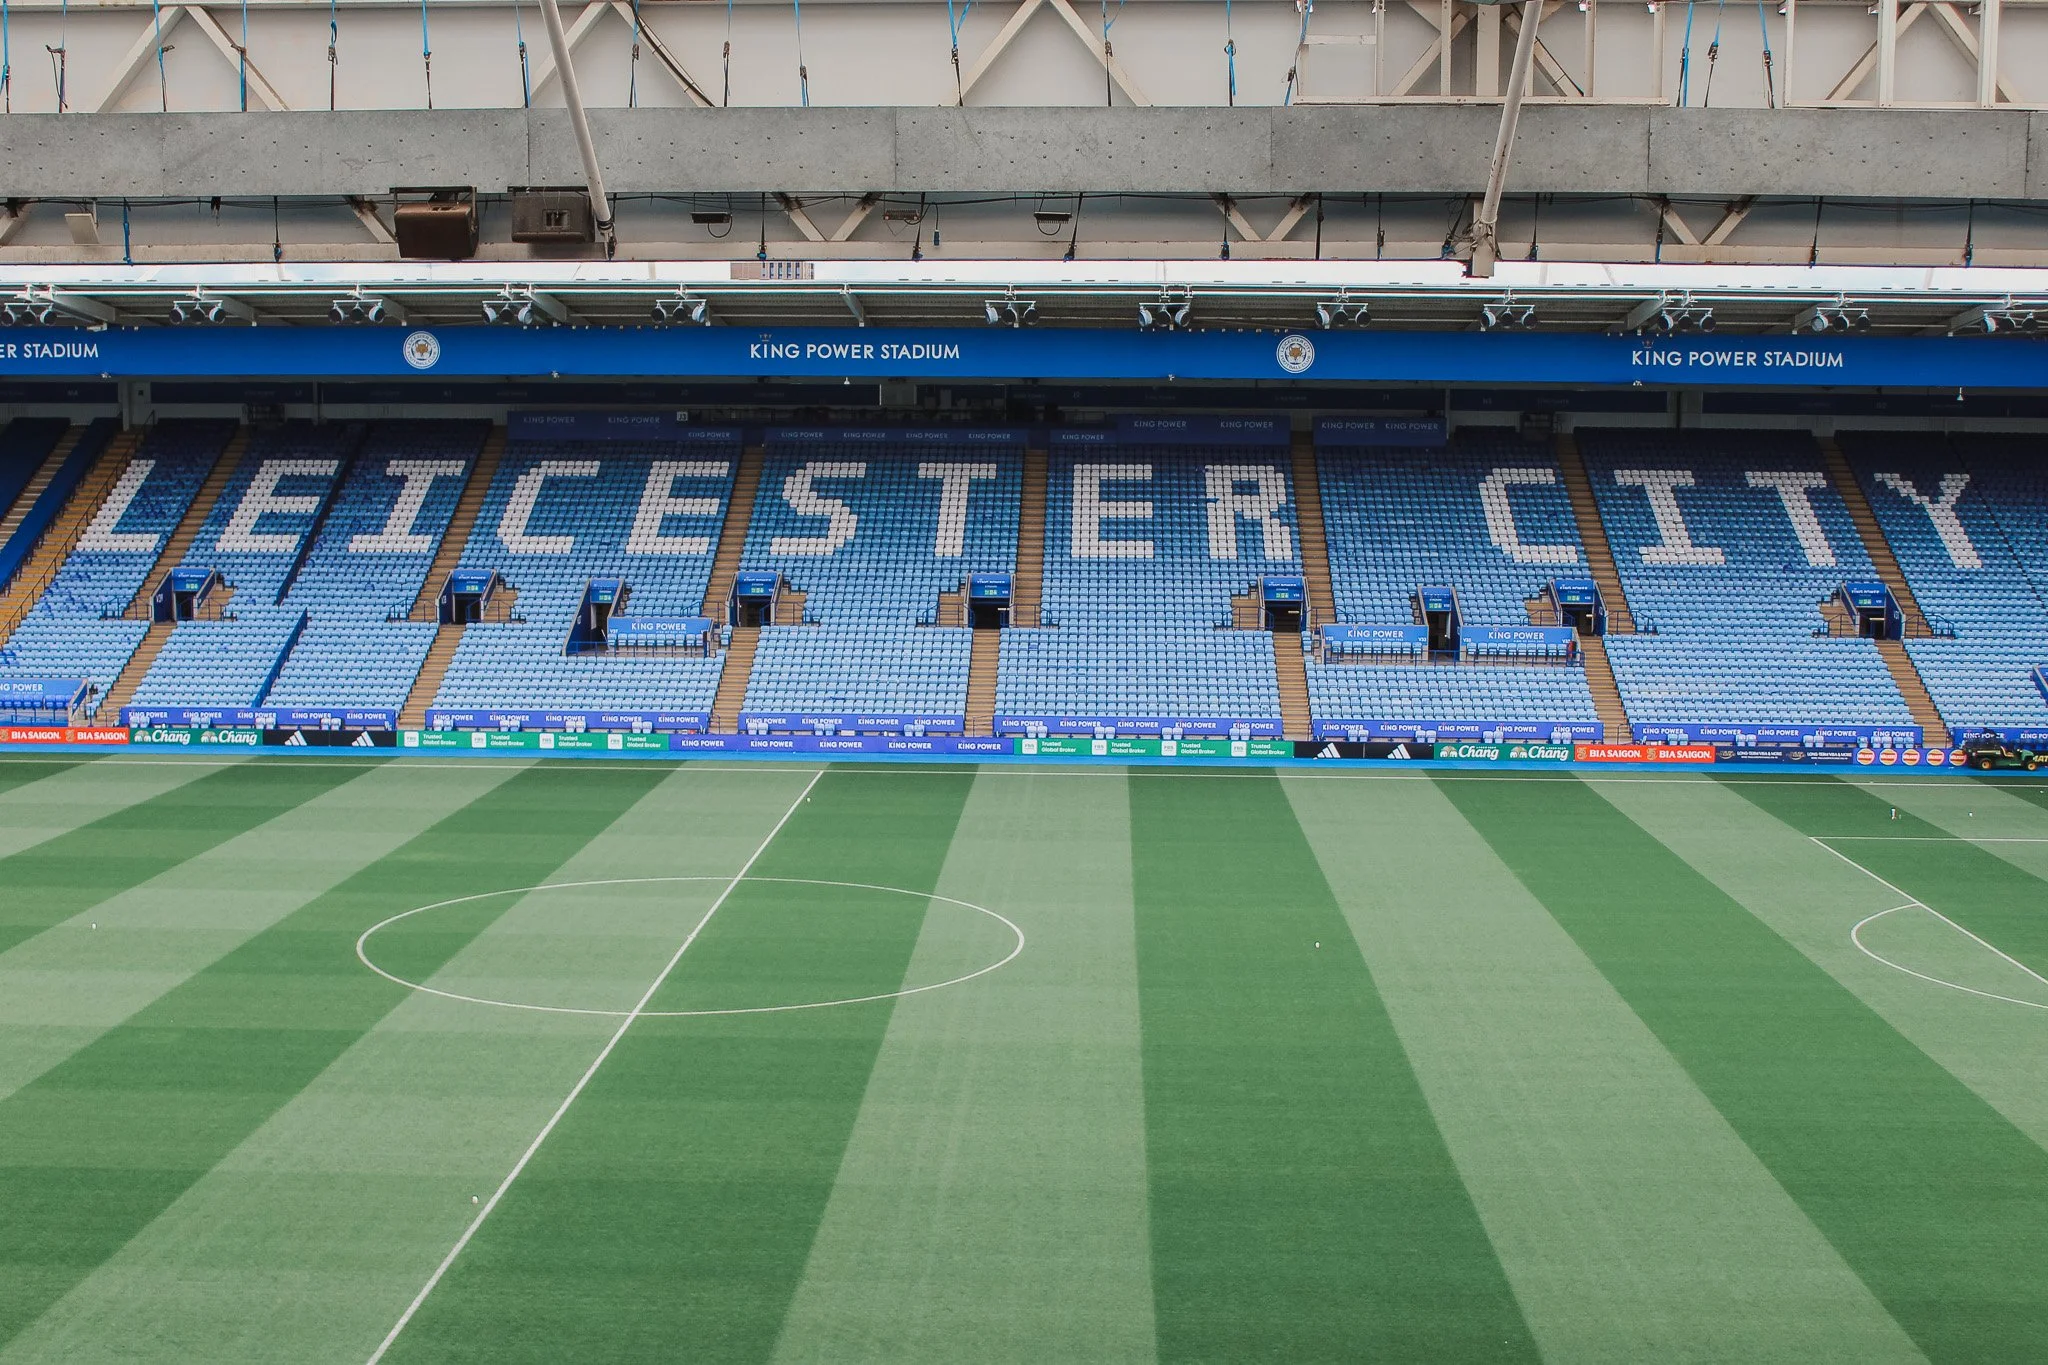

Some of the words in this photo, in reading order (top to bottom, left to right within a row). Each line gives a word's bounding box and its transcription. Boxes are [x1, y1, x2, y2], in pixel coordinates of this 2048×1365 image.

[23, 343, 99, 358] STADIUM
[750, 343, 800, 359] KING
[806, 344, 874, 359] POWER
[880, 344, 960, 360] STADIUM
[1632, 350, 1682, 366] KING
[1688, 351, 1757, 367] POWER
[1763, 351, 1843, 367] STADIUM
[1134, 420, 1155, 428] KING
[1158, 420, 1186, 428] POWER
[1221, 420, 1242, 429] KING
[1245, 420, 1273, 429] POWER
[1322, 422, 1343, 430] KING
[1346, 422, 1374, 430] POWER
[631, 622, 654, 631] KING
[655, 622, 687, 631] POWER
[1347, 630, 1370, 638] KING
[1372, 630, 1404, 638] POWER
[1488, 631, 1511, 639] KING
[1513, 631, 1545, 639] POWER
[12, 683, 44, 691] POWER
[11, 731, 27, 739] BIA
[77, 731, 94, 740] BIA
[151, 729, 191, 745] Chang
[218, 730, 258, 746] Chang
[1458, 745, 1499, 761] Chang
[1528, 745, 1569, 761] Chang
[1589, 749, 1606, 758] BIA
[1659, 750, 1676, 758] BIA
